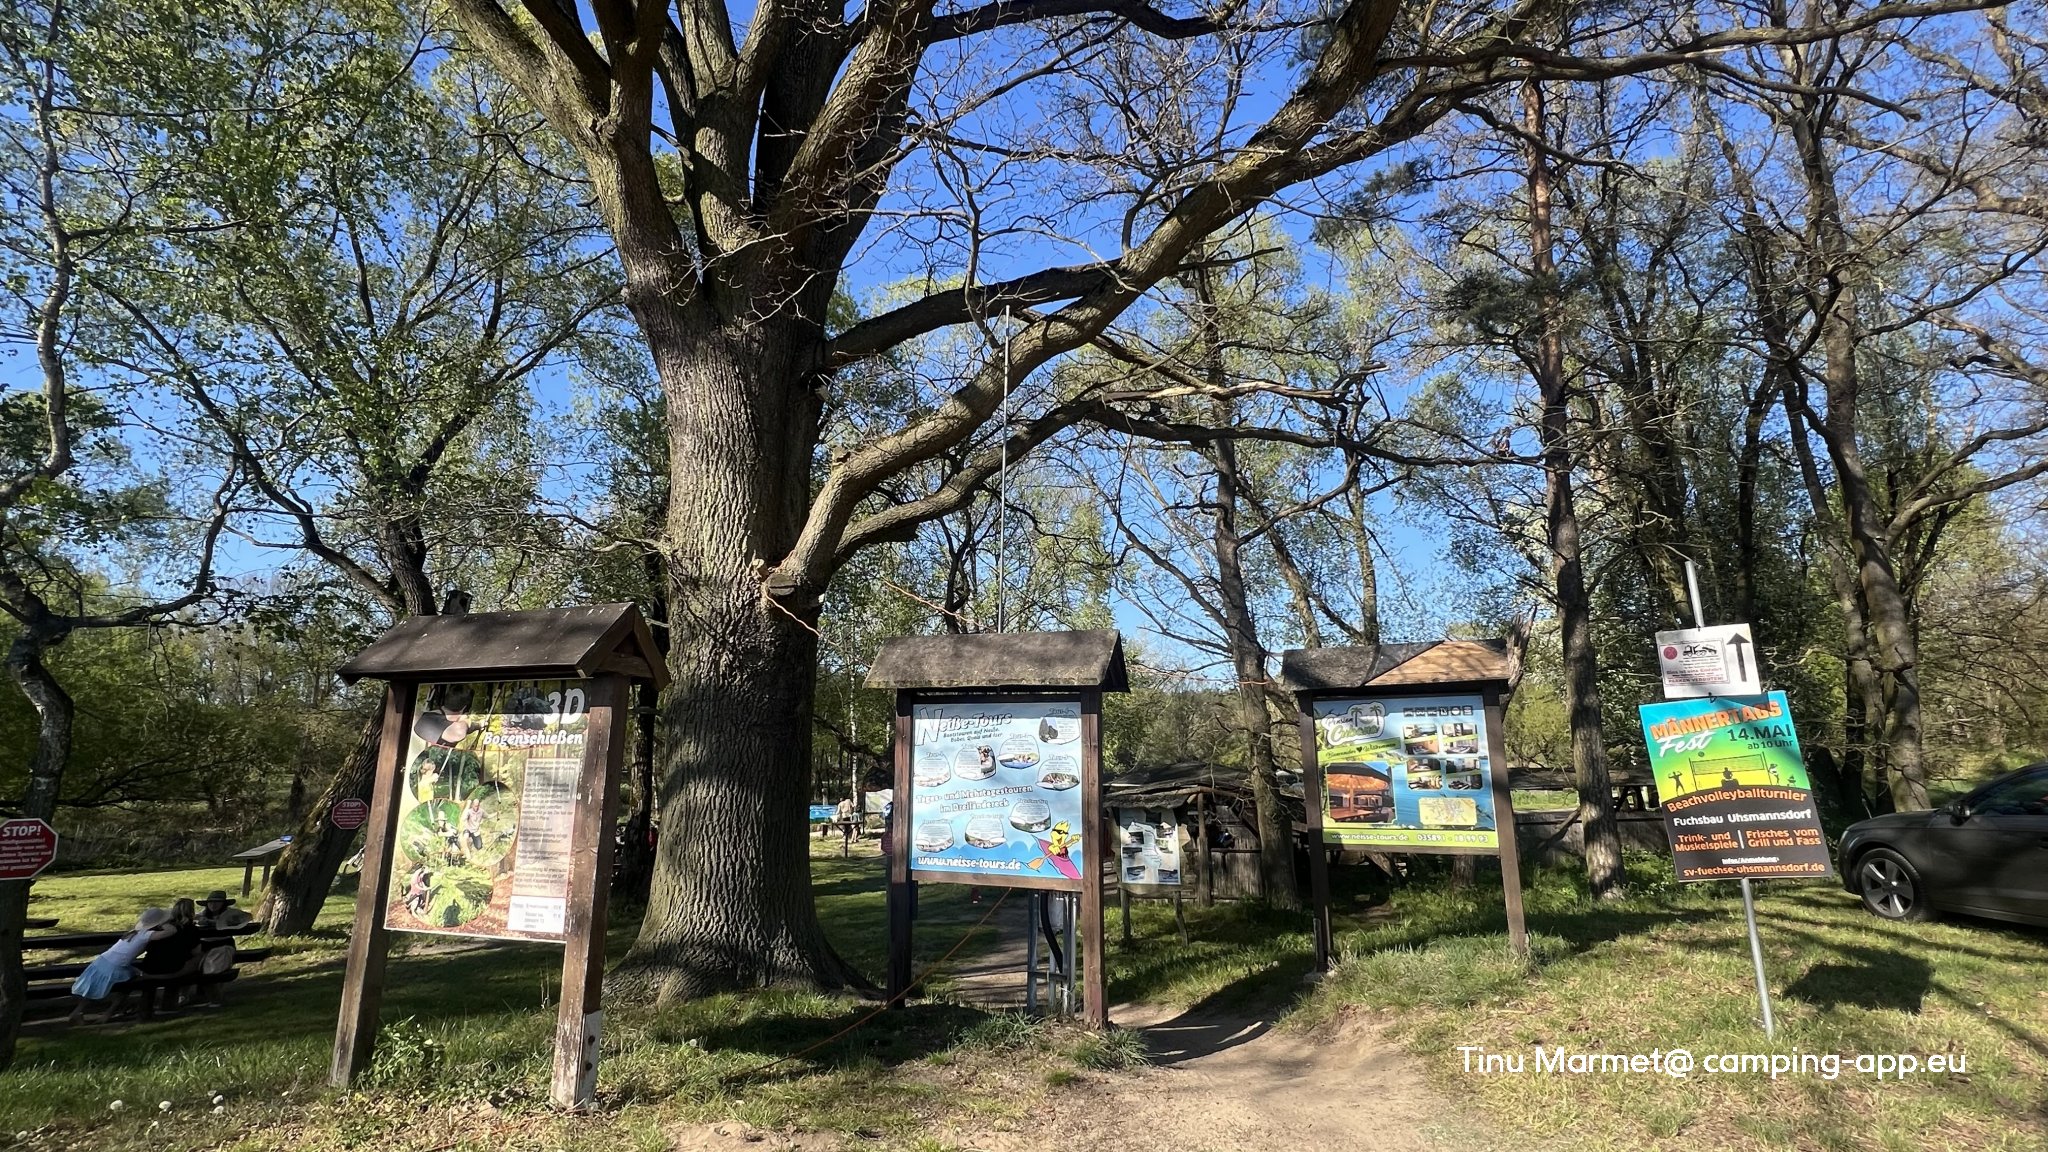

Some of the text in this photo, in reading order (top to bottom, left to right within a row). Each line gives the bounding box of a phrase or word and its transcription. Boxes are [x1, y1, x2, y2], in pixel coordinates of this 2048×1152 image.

[543, 688, 585, 725] 3D
[914, 706, 1013, 746] Neiße-Tours
[1650, 701, 1783, 740] MÄNNERTAGS
[483, 729, 583, 747] Bogenschießen
[1727, 724, 1792, 742] 14.MAI
[1656, 730, 1716, 758] Fest
[1747, 738, 1794, 750] ab 10 Uhr
[943, 790, 961, 801] und
[961, 784, 1034, 801] Mehrtagestouren
[1666, 788, 1808, 813] Beachvolleyballturnier
[952, 797, 1010, 813] Dreiländereck
[1673, 808, 1812, 827] Fuchsbau Uhsmannsdorf
[2, 825, 42, 837] STOP!
[1677, 831, 1731, 843] Trink- und
[1746, 827, 1819, 839] Frisches vom
[1675, 839, 1739, 852] Muskelspiele
[1748, 836, 1822, 848] Grill und Fass
[917, 855, 1022, 870] www.neisse-tours.de
[1683, 862, 1826, 877] sv-fuechse-uhsmannsdorf.de
